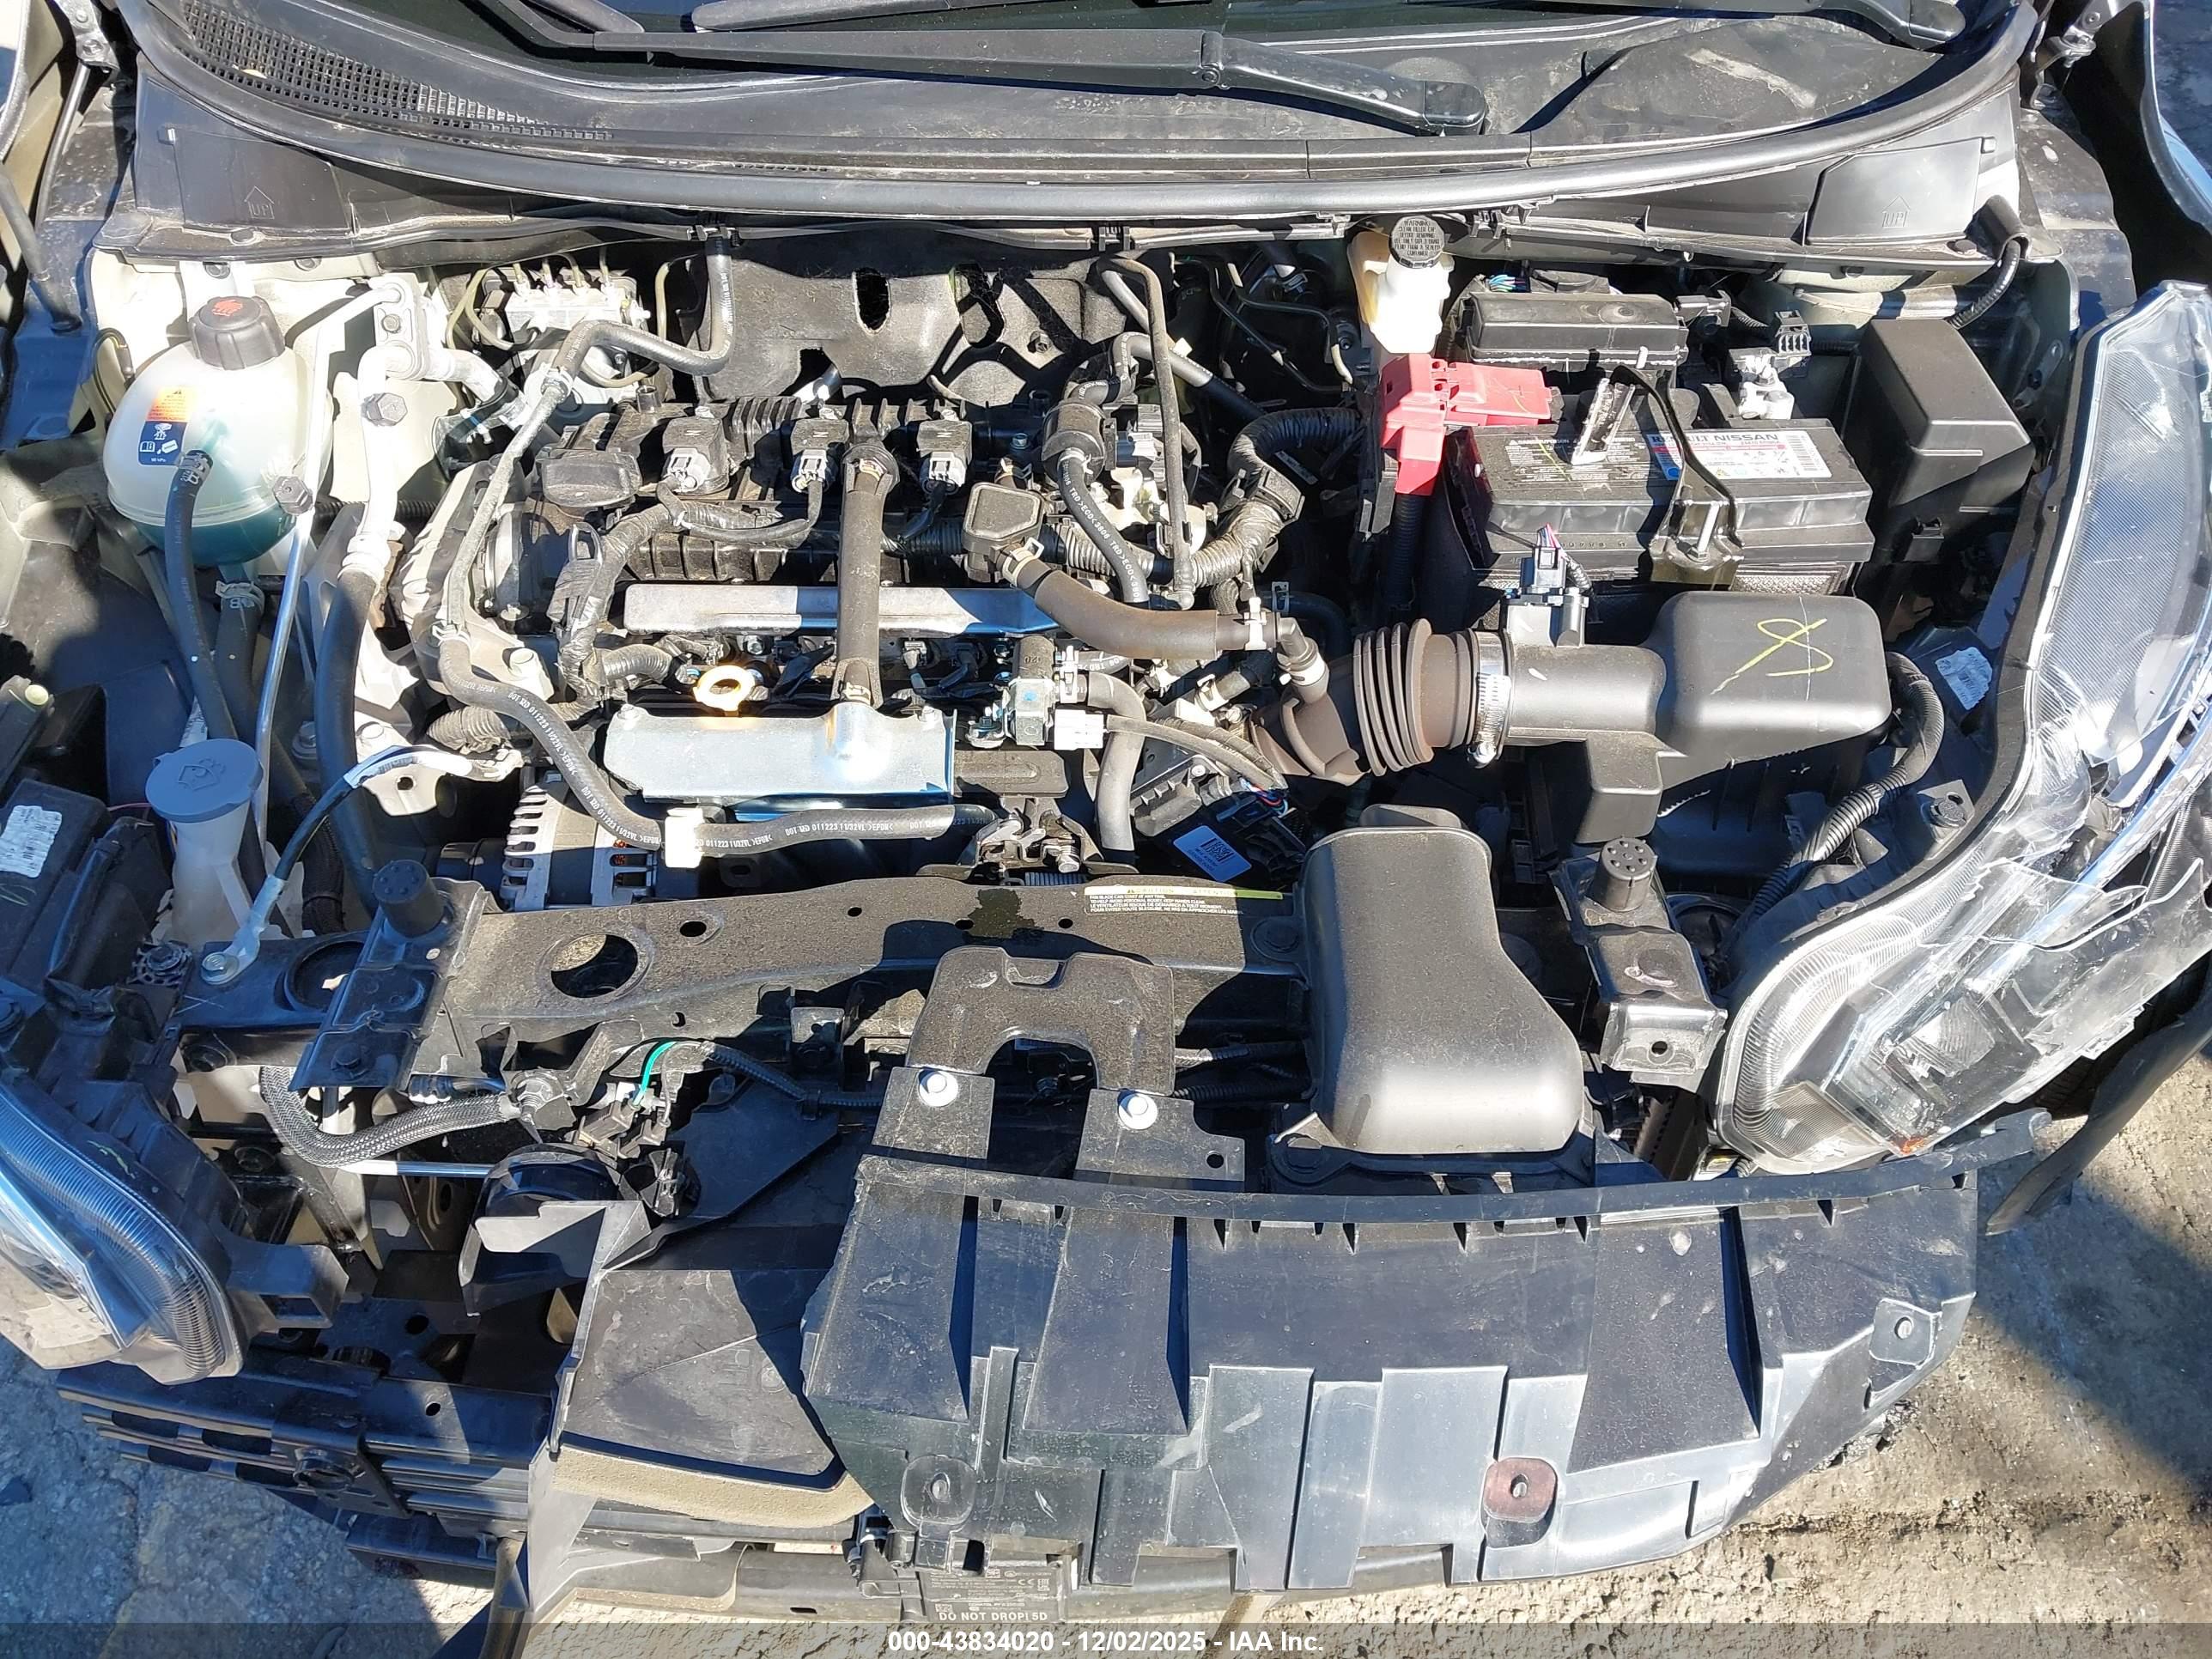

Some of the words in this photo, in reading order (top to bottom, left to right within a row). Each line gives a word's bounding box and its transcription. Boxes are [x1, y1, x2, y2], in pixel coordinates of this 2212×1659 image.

[1886, 211, 1904, 226] UP
[507, 692, 520, 702] DOT
[785, 827, 798, 836] DOT
[811, 823, 839, 832] 011223
[939, 1612, 957, 1621] DO
[961, 1612, 987, 1621] NOT
